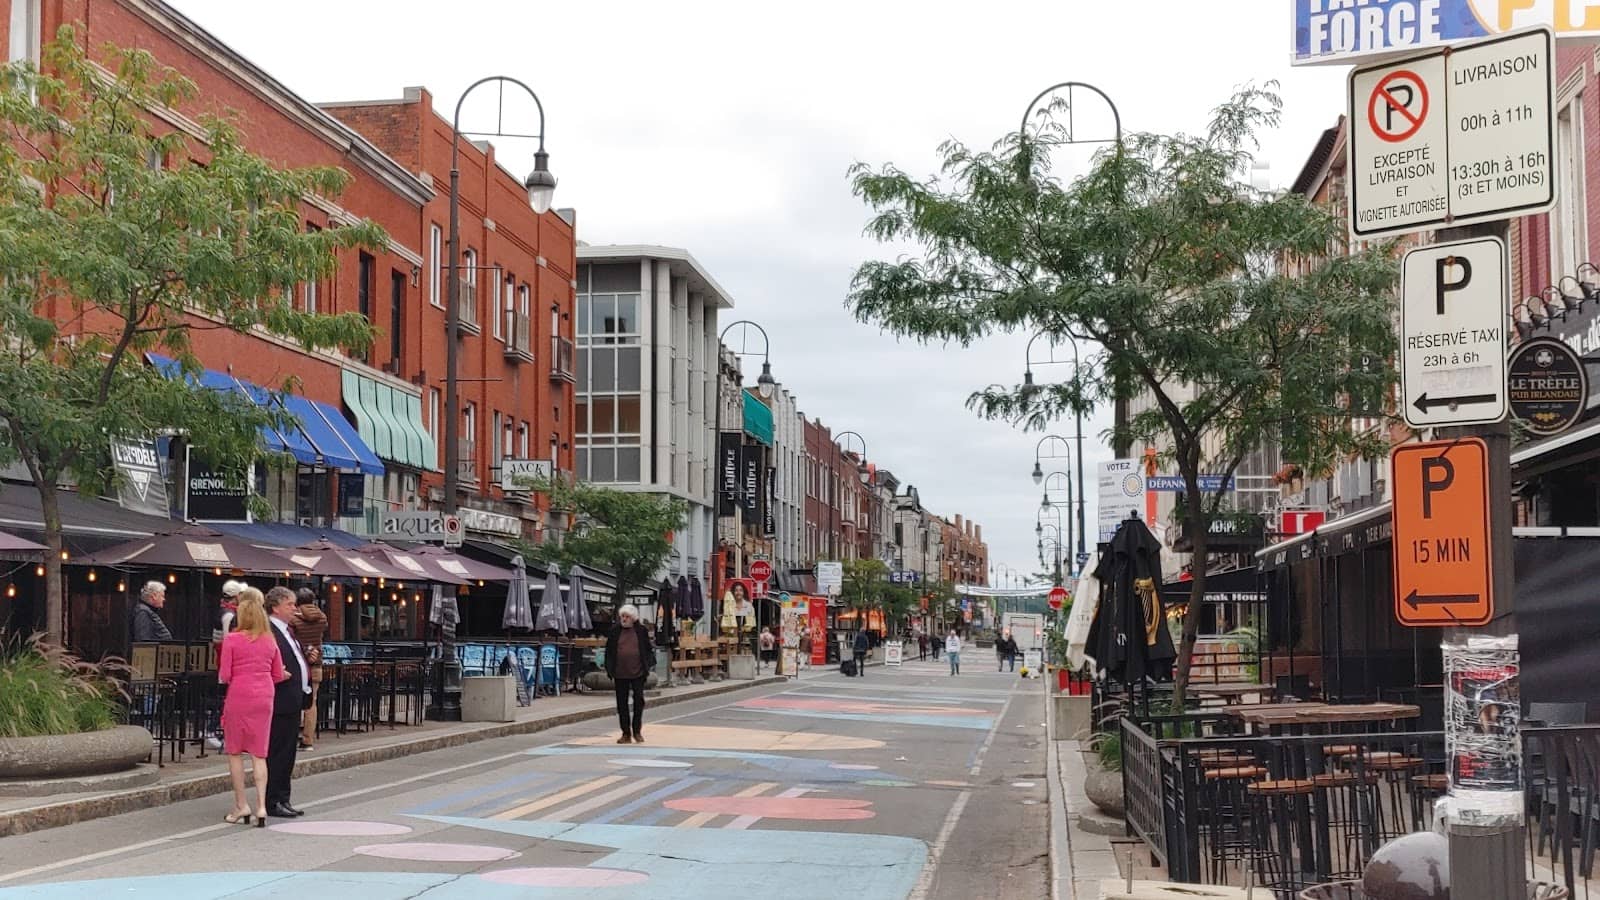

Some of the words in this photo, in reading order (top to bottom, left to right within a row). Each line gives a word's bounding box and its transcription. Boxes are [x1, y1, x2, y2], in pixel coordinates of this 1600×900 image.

[1310, 1, 1441, 56] FORCE
[1454, 53, 1538, 86] LIVRAISON
[1460, 113, 1488, 132] 00h
[1492, 109, 1501, 126] à
[1506, 105, 1533, 122] 11h
[1374, 145, 1430, 169] EXCEPTÉ
[1452, 159, 1500, 181] 13:30h
[1505, 154, 1514, 171] à
[1518, 152, 1545, 169] 16h
[1369, 162, 1435, 186] LIVRAISON
[1458, 181, 1474, 199] (3t
[1476, 179, 1492, 194] ET
[1496, 170, 1545, 191] MOINS)
[1396, 185, 1409, 197] ET
[1359, 202, 1398, 224] VIGNETTE
[1399, 195, 1446, 218] AUTORISÉE
[1435, 255, 1472, 316] P
[1408, 328, 1467, 350] RÉSERVÉ
[1470, 328, 1500, 344] TAXI
[1423, 353, 1447, 367] 23h
[1451, 352, 1459, 365] à
[1463, 351, 1480, 364] 6h
[1511, 378, 1527, 390] LE
[1528, 376, 1580, 390] TRÈFLE
[1511, 391, 1529, 399] PUB
[1531, 390, 1580, 399] IRLANDAIS
[510, 462, 546, 476] JACK
[1106, 462, 1131, 472] VOTEZ
[1148, 477, 1206, 489] DÉPANNR
[1421, 457, 1455, 520] P
[1412, 539, 1430, 564] 15
[1436, 537, 1471, 563] MIN
[751, 566, 770, 576] ARRÊT
